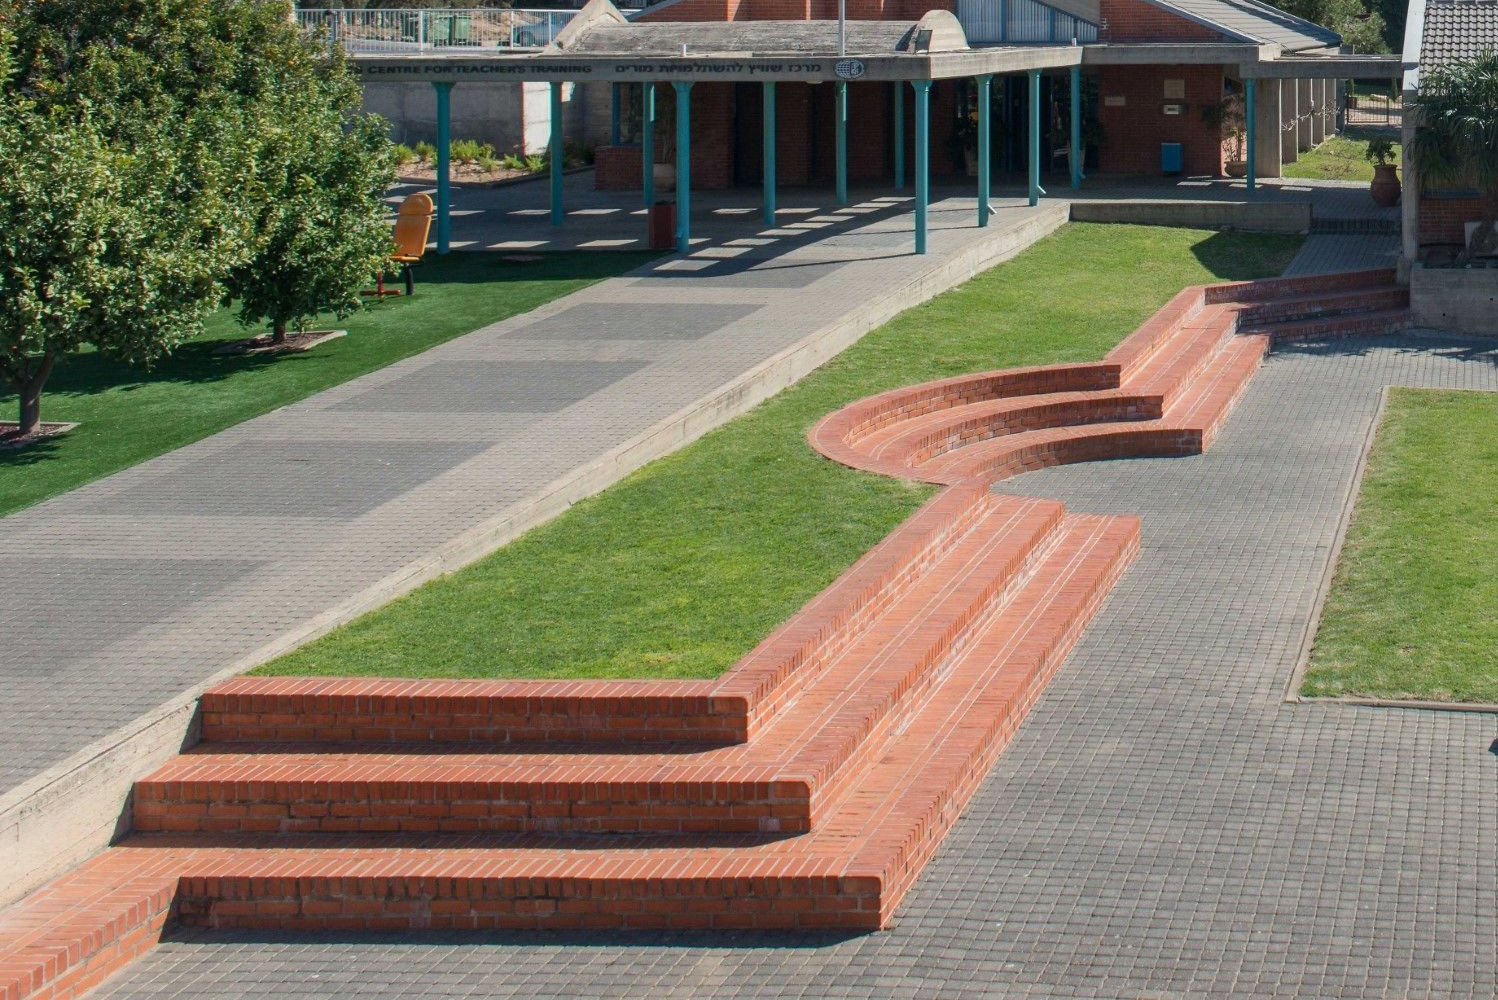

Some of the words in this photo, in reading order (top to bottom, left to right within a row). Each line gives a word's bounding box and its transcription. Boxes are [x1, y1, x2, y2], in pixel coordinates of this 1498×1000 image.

[368, 65, 420, 74] CENTRE
[424, 65, 453, 74] FOR
[456, 65, 526, 74] TEACHER'S
[530, 65, 592, 73] TRAINING
[615, 64, 653, 73] מורים
[749, 63, 783, 74] שוויץ
[788, 63, 822, 73] מרכז
